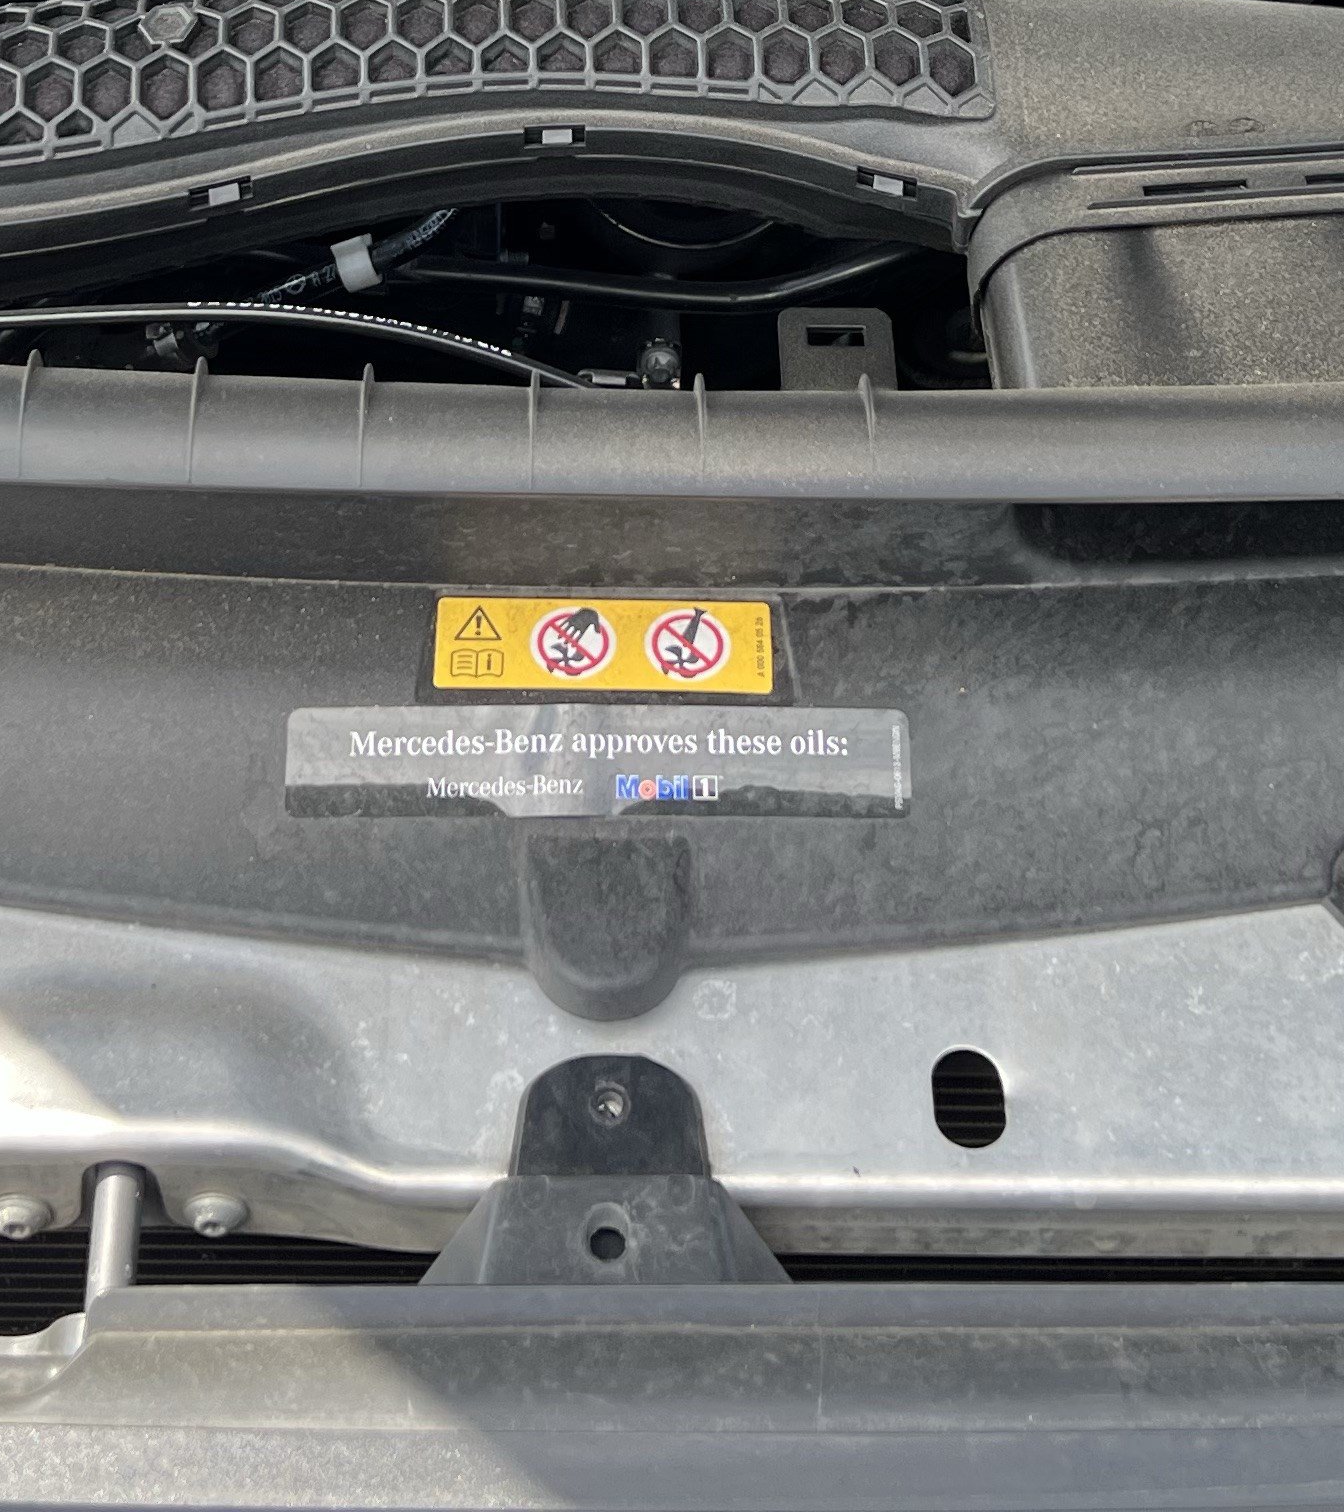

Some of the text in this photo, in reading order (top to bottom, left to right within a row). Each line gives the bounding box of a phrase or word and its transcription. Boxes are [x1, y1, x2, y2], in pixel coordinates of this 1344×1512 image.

[349, 728, 849, 760] Mercedes-Benz approves these oils:
[425, 774, 584, 799] Mercedes-Benz
[616, 774, 689, 800] Mobil
